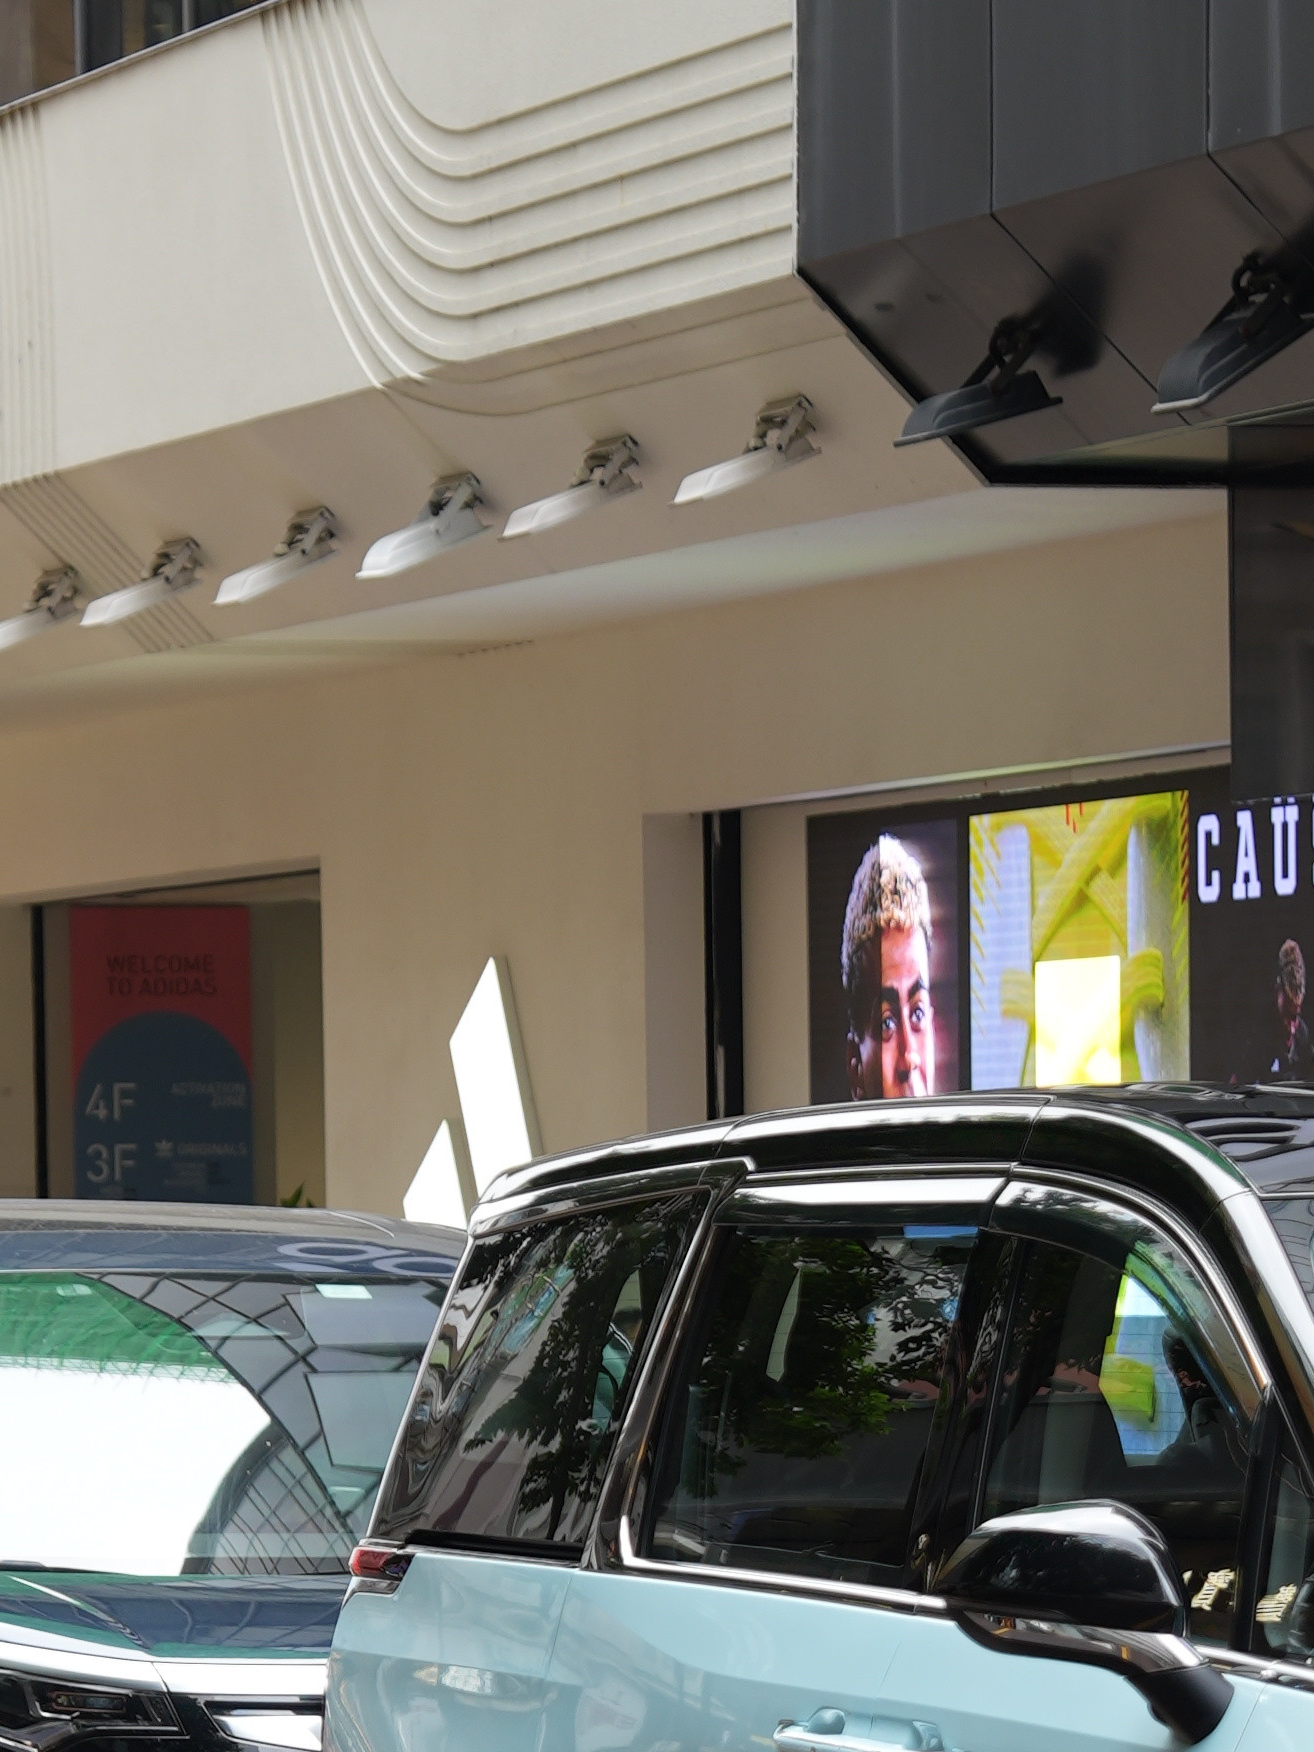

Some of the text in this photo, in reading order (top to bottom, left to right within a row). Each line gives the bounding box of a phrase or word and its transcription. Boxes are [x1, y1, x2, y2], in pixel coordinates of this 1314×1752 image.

[106, 954, 215, 975] WELCOME
[106, 977, 218, 996] TO ADIDAS
[85, 1083, 137, 1122] 4F
[86, 1143, 138, 1184] 3F
